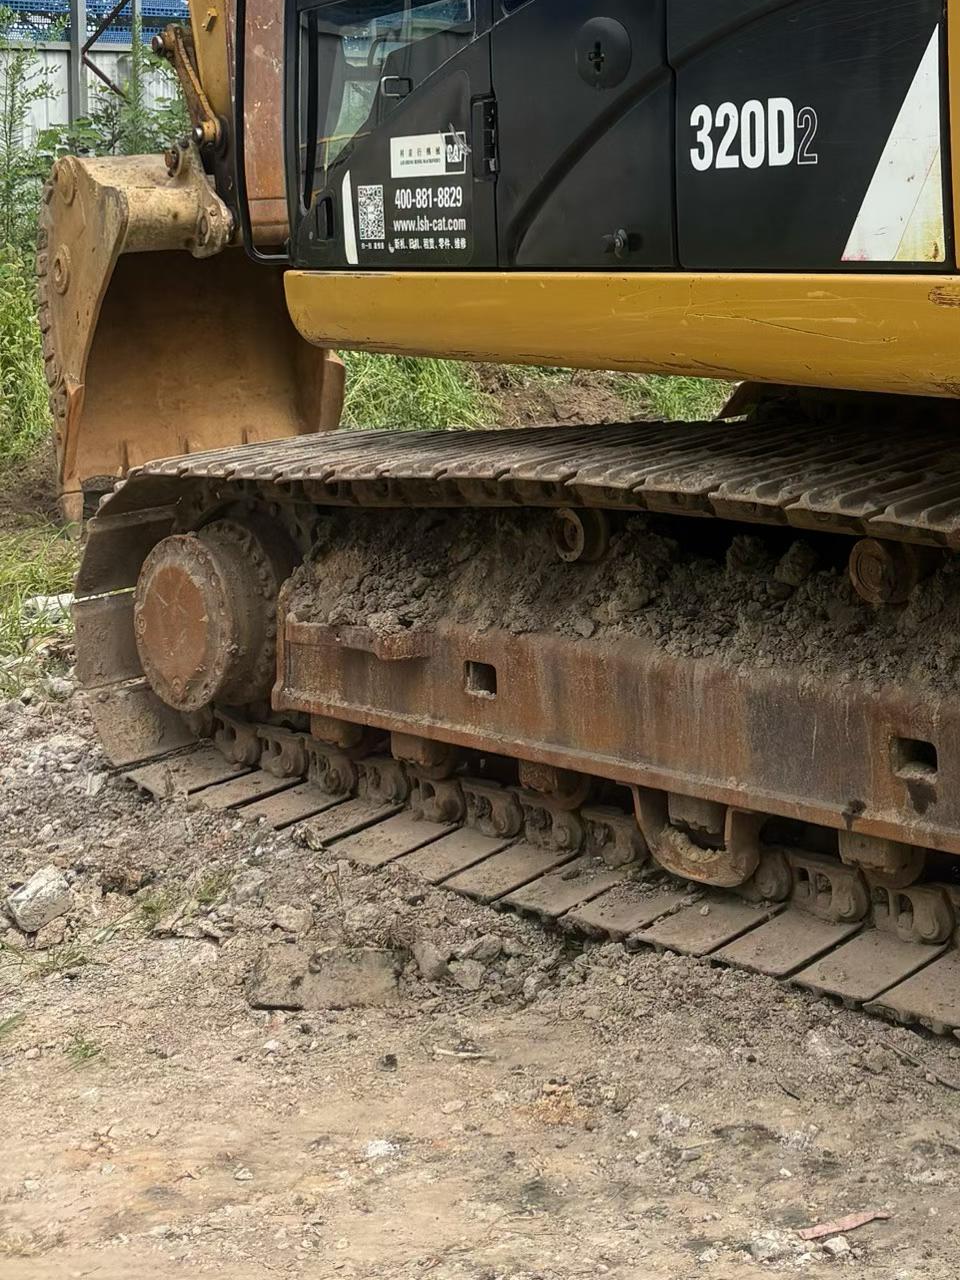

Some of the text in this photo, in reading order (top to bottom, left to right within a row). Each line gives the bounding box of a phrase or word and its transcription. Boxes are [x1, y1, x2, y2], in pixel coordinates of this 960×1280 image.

[690, 97, 818, 171] 320D2
[395, 187, 463, 209] 400-881-8829
[393, 216, 466, 231] www.lsh-cat.com
